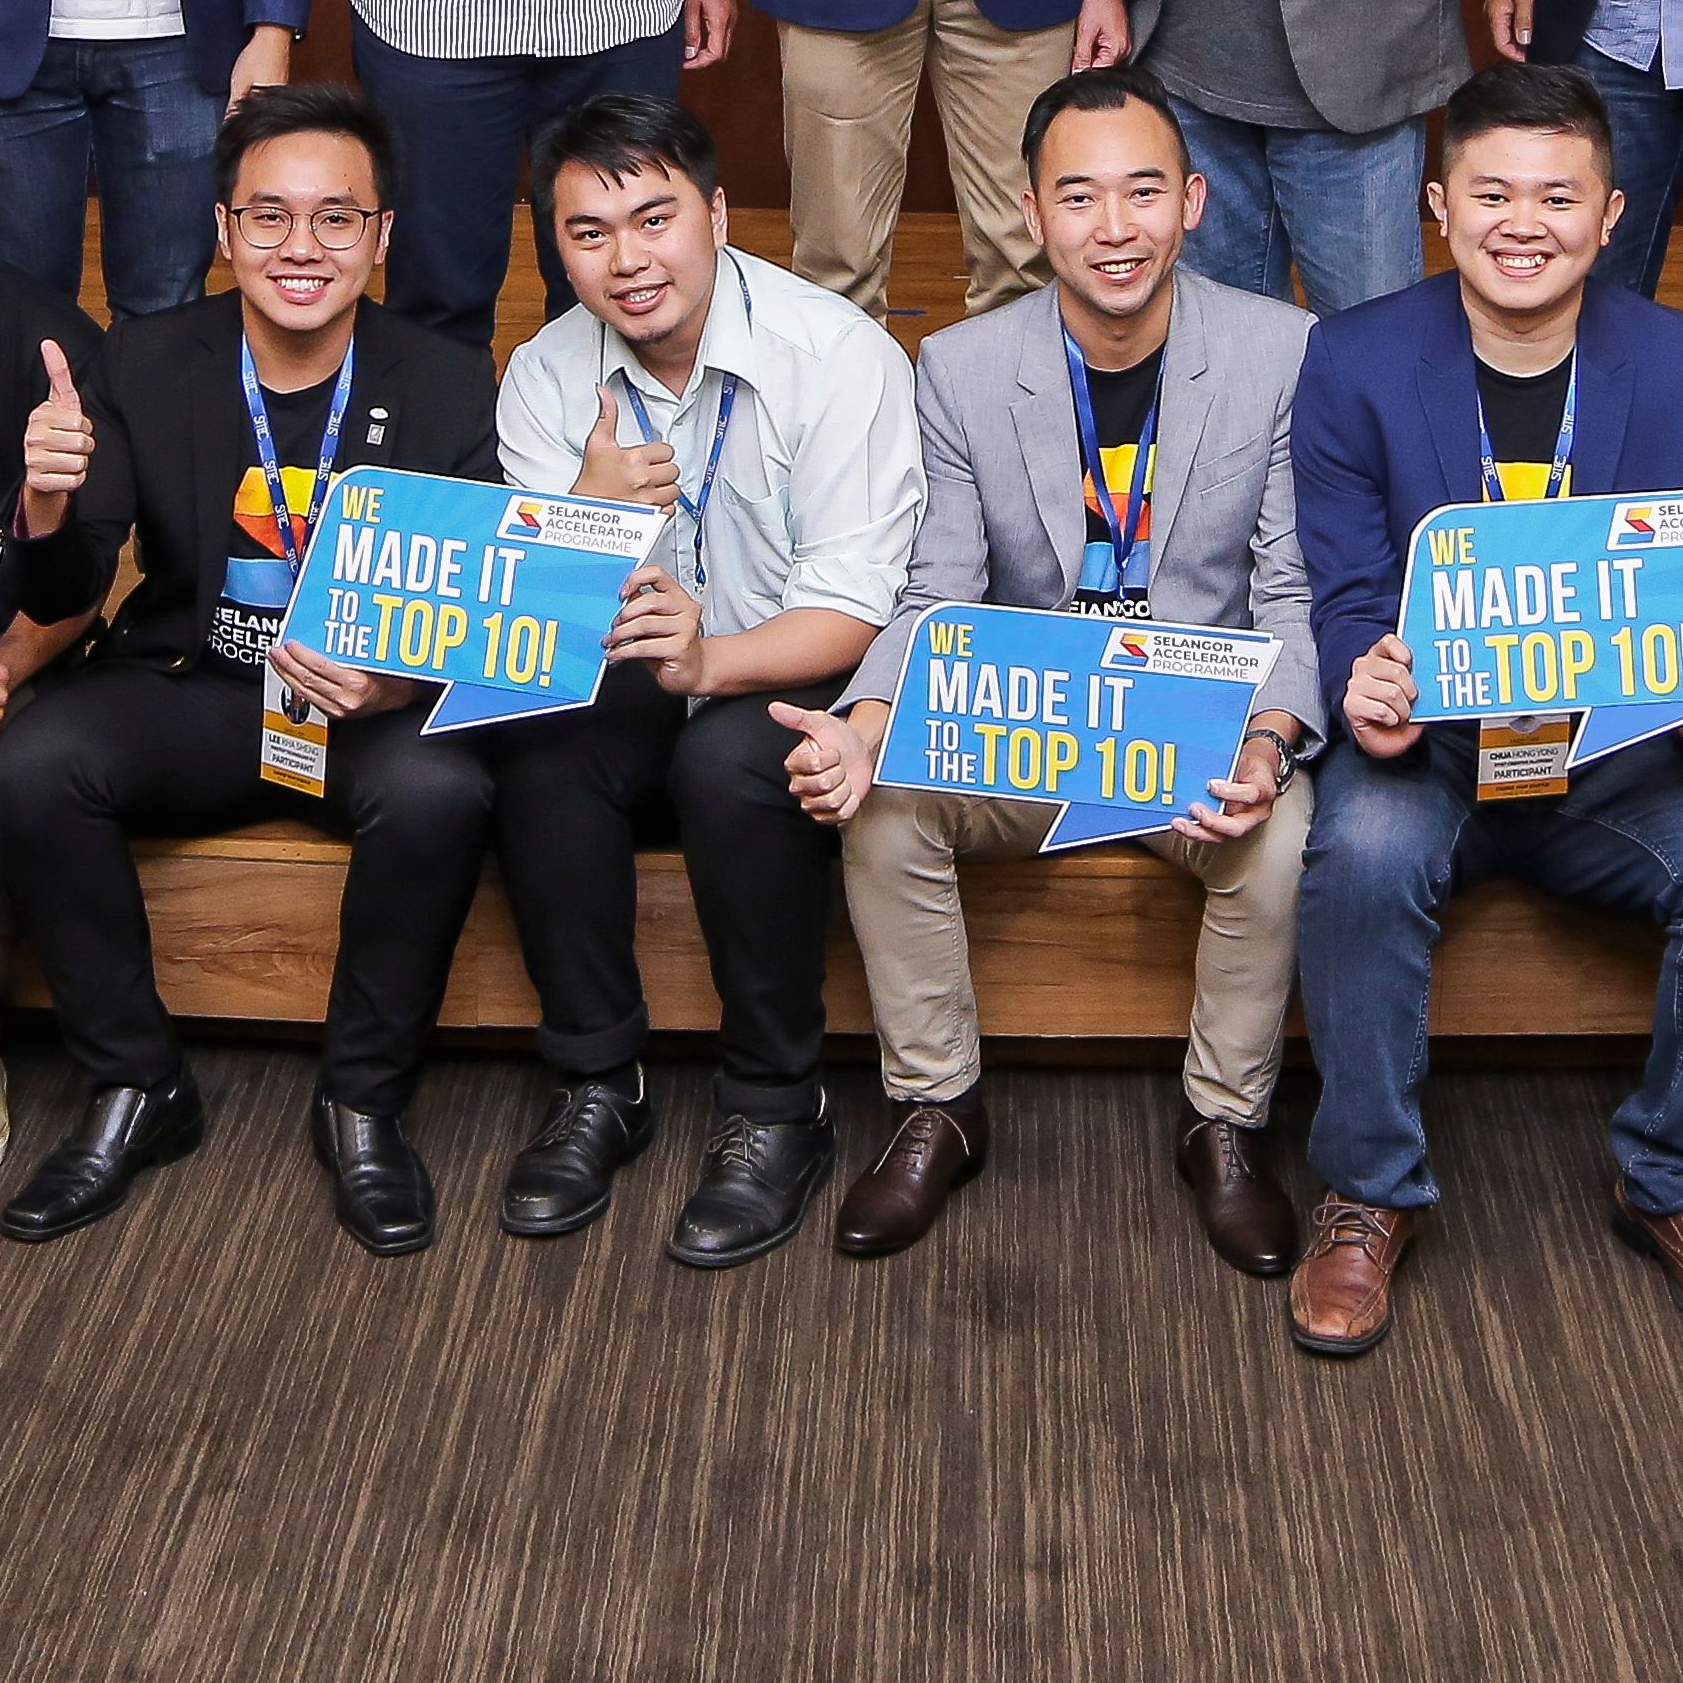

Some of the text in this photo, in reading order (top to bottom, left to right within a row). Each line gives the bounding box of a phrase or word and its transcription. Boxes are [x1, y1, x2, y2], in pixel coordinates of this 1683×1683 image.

[341, 484, 384, 525] WE
[332, 523, 526, 606] MADE IT
[1428, 527, 1476, 567] WE
[328, 588, 360, 623] TO
[1431, 557, 1645, 632] MADE IT
[324, 619, 372, 660] THE
[372, 593, 560, 689] TOP 10!
[928, 621, 974, 658] WE
[1434, 638, 1472, 674] TO
[1485, 627, 1596, 705] TOP
[927, 657, 1135, 732] MADE IT
[1436, 670, 1492, 709] THE
[925, 718, 960, 752] TO
[925, 748, 977, 785] THE
[973, 722, 1178, 805] TOP 10!
[1494, 766, 1552, 779] PARTICIPANT
